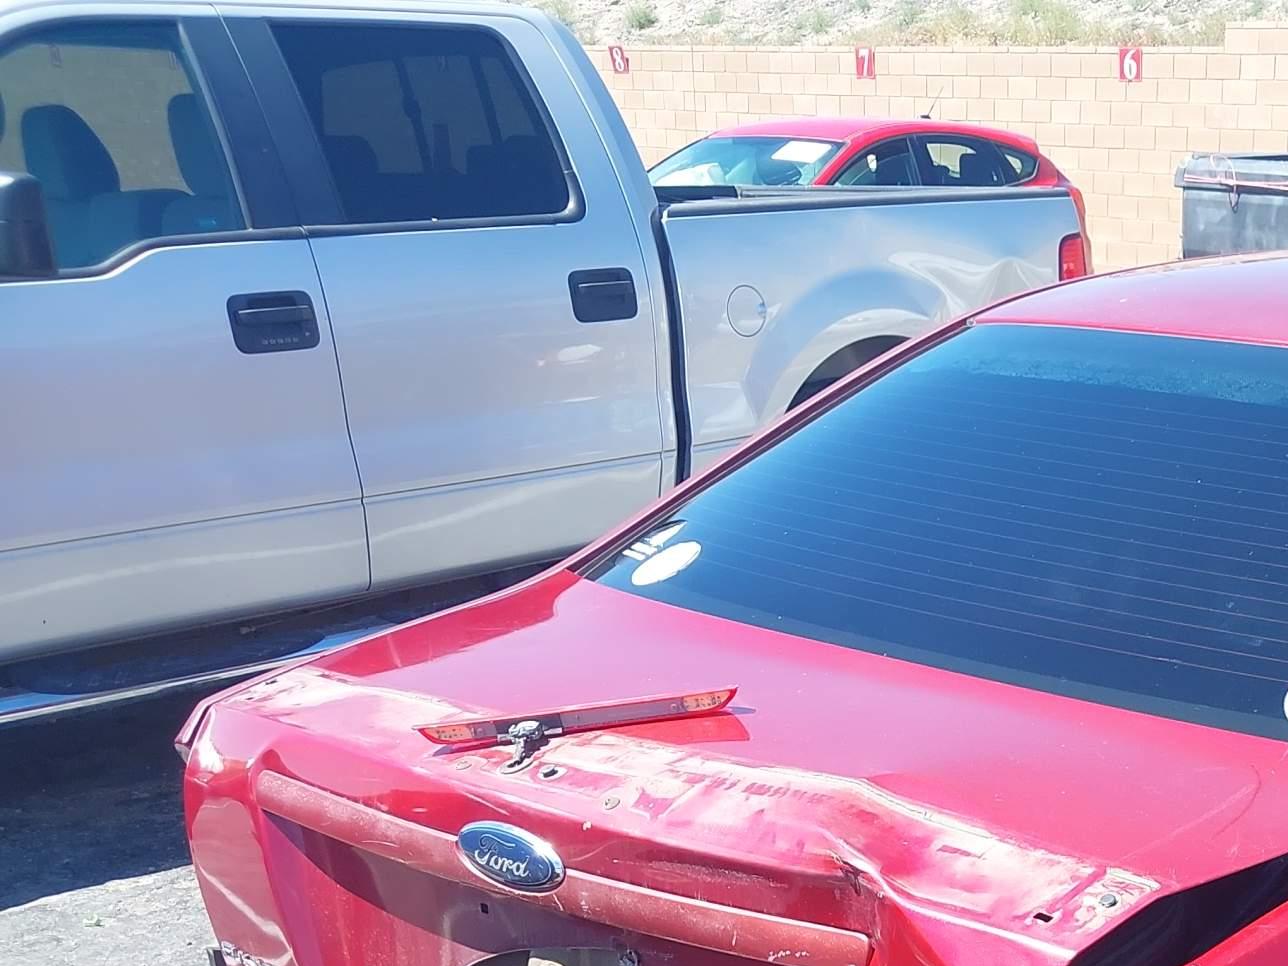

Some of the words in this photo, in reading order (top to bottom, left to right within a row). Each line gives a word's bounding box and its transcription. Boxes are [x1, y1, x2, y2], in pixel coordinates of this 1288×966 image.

[612, 47, 625, 72] 8
[857, 48, 870, 78] 7
[1123, 49, 1138, 80] 6
[474, 833, 531, 878] Ford
